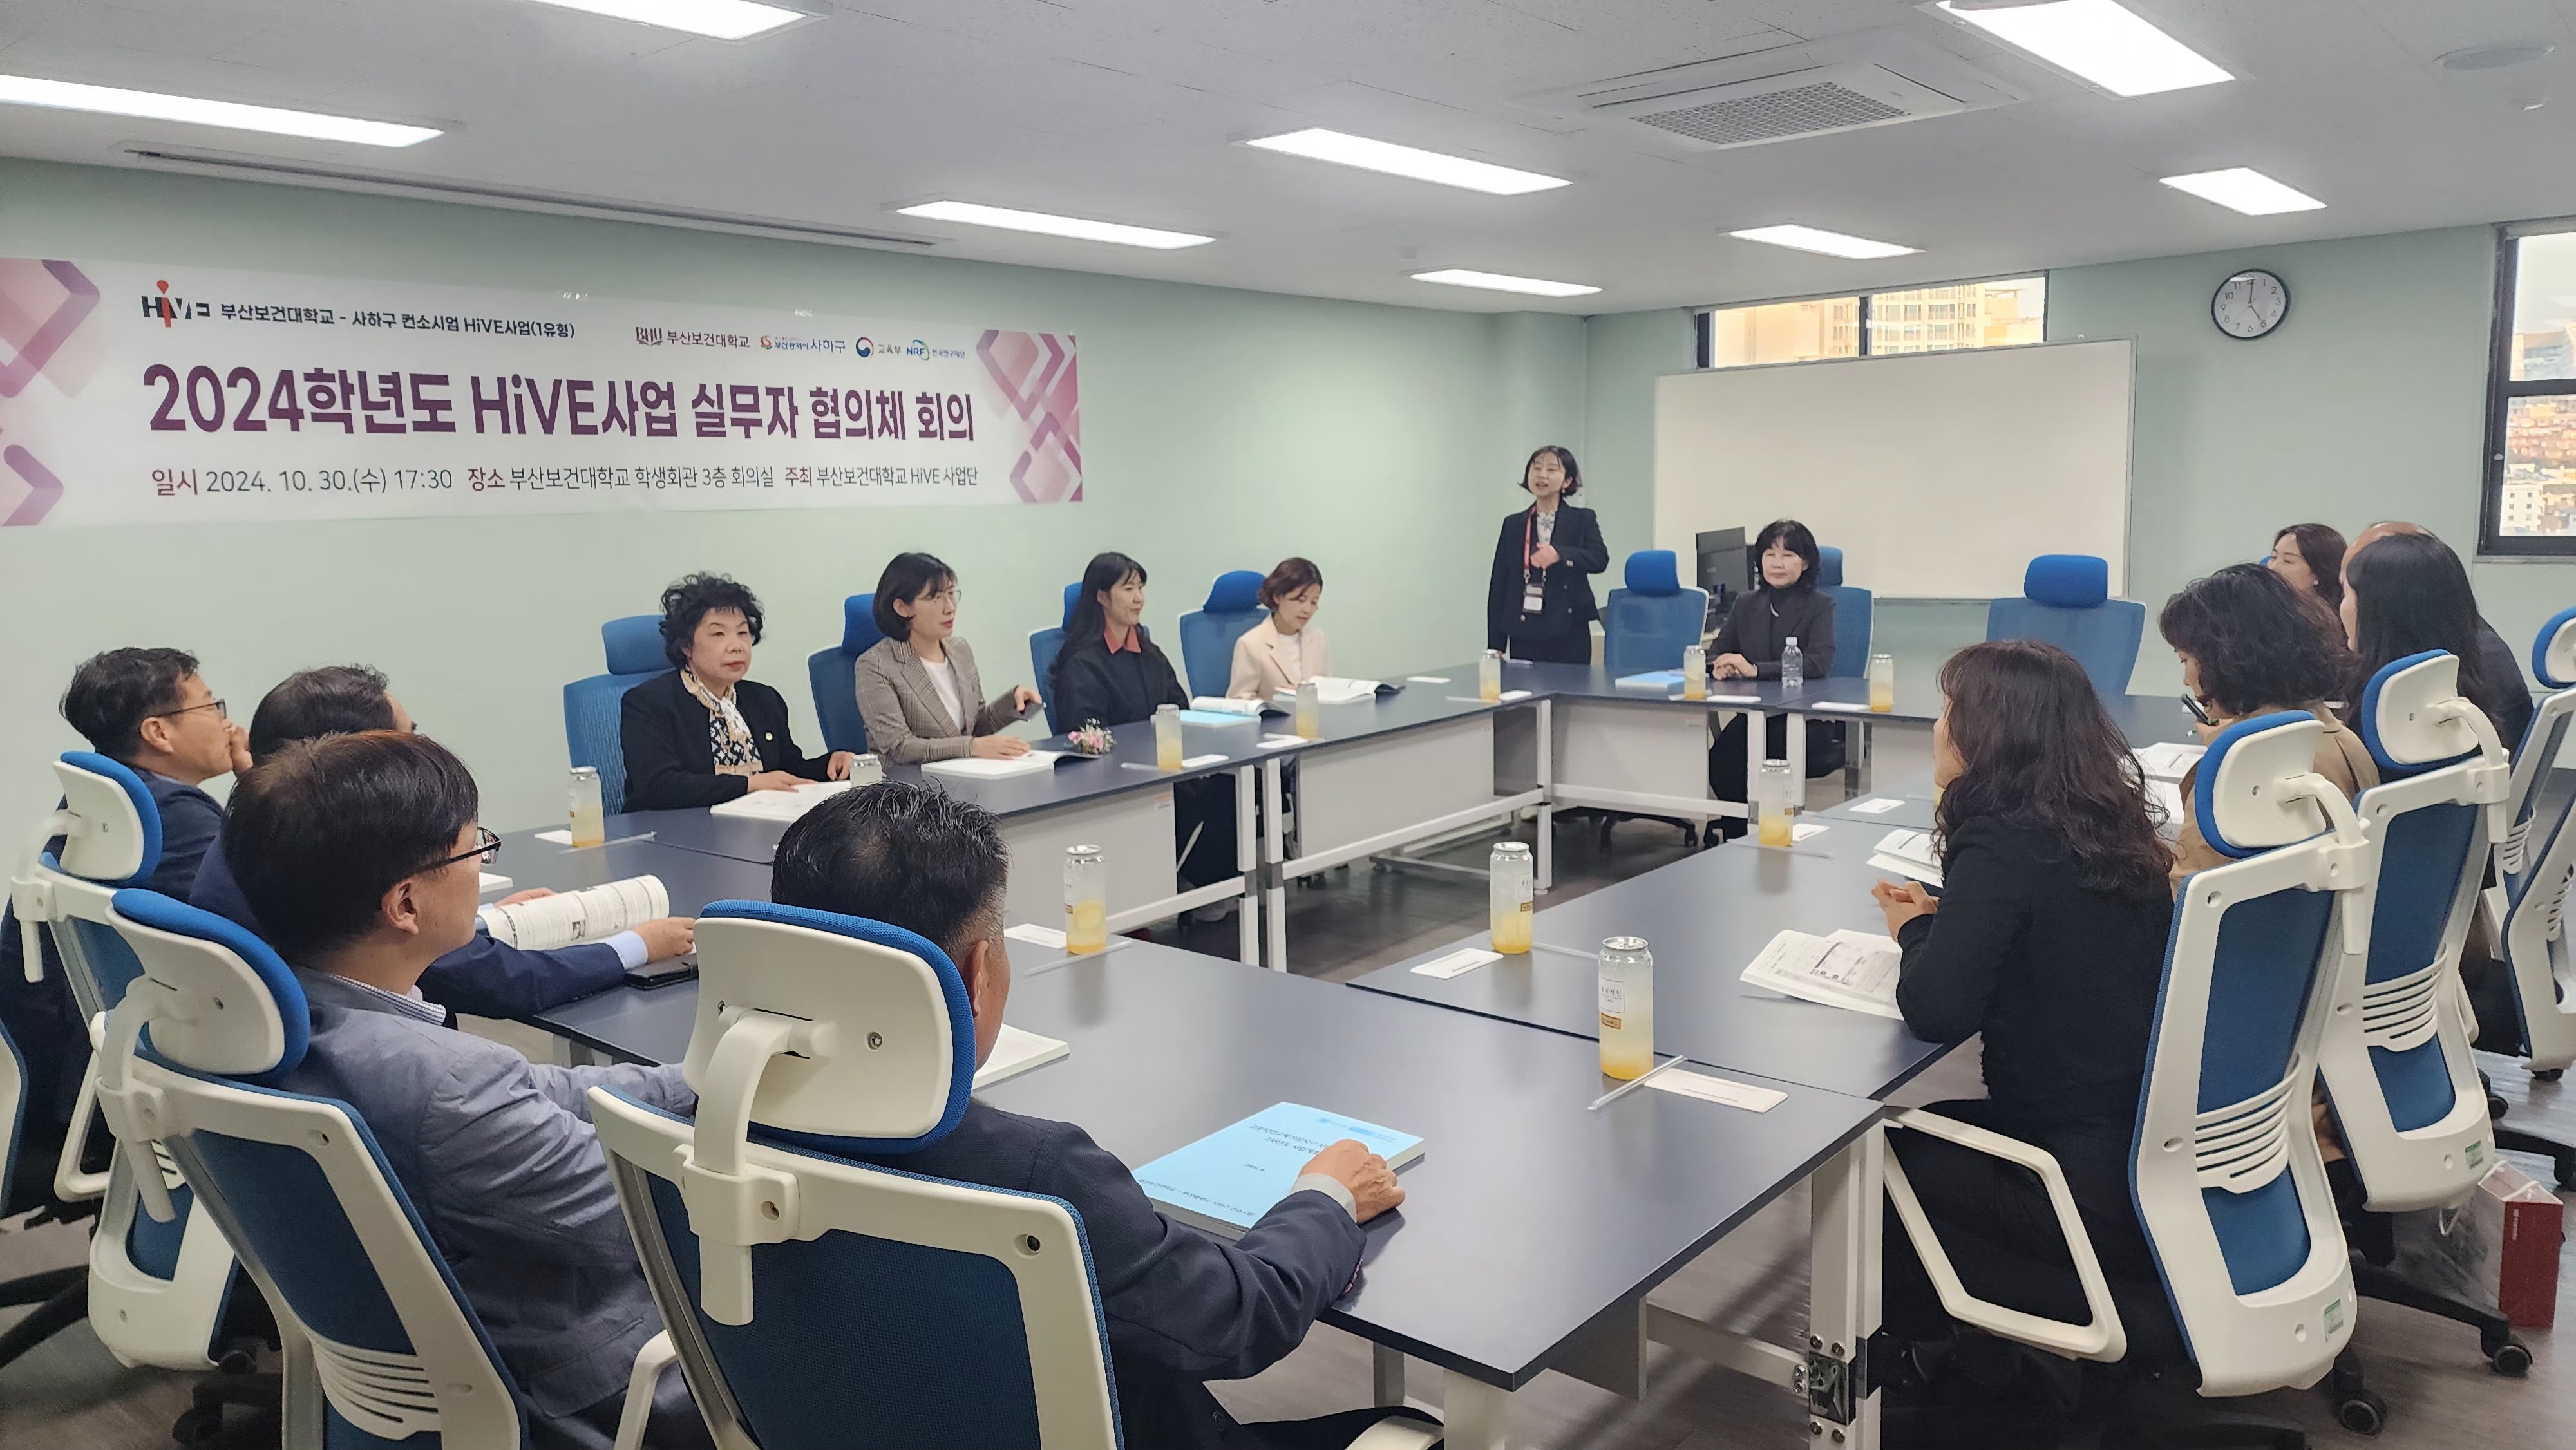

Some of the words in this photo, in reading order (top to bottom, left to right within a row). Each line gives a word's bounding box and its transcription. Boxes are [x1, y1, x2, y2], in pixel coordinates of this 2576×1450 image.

[2224, 292, 2234, 301] 10
[221, 304, 334, 324] 부산보건대학교
[352, 312, 397, 328] 사하구
[401, 314, 459, 332] 컨소시엄
[464, 318, 574, 338] HiVE사업(1유형)
[2224, 315, 2230, 323] 8
[667, 330, 750, 348] 부산보건대학교
[906, 346, 926, 357] NRF
[144, 364, 456, 434] 2024학년도
[471, 374, 677, 437] HiVE사업
[692, 383, 799, 438] 실무자
[809, 387, 905, 440] 협의체
[916, 392, 974, 441] 회의
[152, 469, 198, 496] 일시
[206, 471, 270, 492] 2024.
[279, 471, 312, 491] 10.
[319, 468, 386, 493] 30.(수)
[395, 470, 451, 489] 17:30
[468, 467, 505, 491] 장소
[510, 467, 630, 490] 부산보건대학교
[635, 466, 697, 489] 학생회관
[703, 467, 726, 488] 3층
[732, 466, 773, 487] 회의실
[785, 467, 811, 487] 주최
[817, 466, 907, 487] 부산보건대학교
[911, 468, 940, 484] HiVE
[943, 467, 978, 485] 사업단
